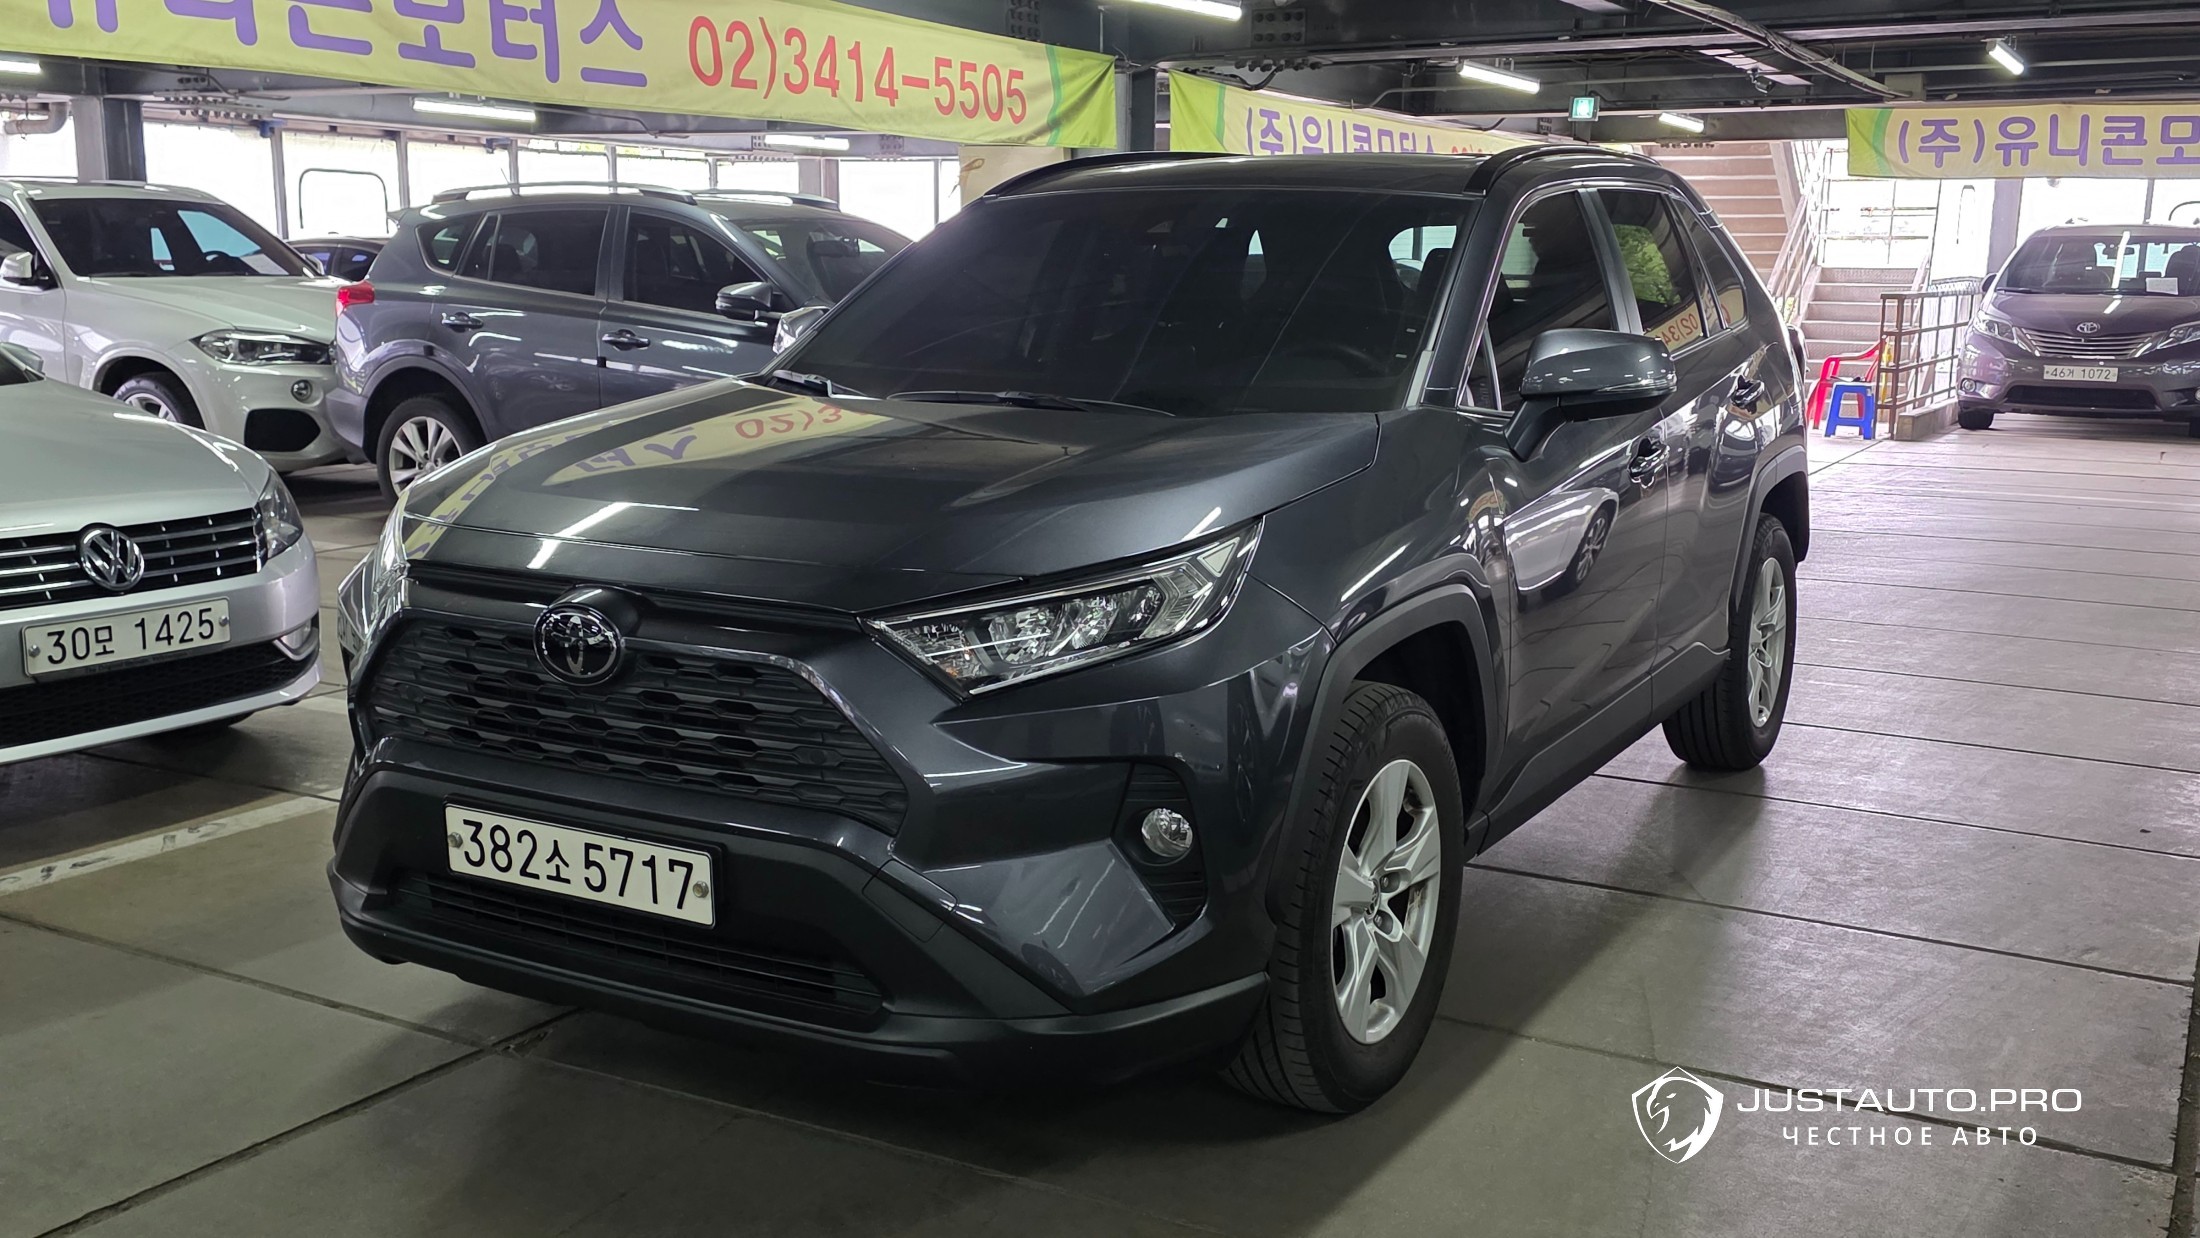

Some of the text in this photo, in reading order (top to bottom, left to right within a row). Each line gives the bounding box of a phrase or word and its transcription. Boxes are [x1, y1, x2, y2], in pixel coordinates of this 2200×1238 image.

[688, 16, 1027, 124] 02)3414-5505
[2081, 368, 2111, 380] 1072
[47, 625, 115, 665] 30모
[134, 607, 214, 650] 1425
